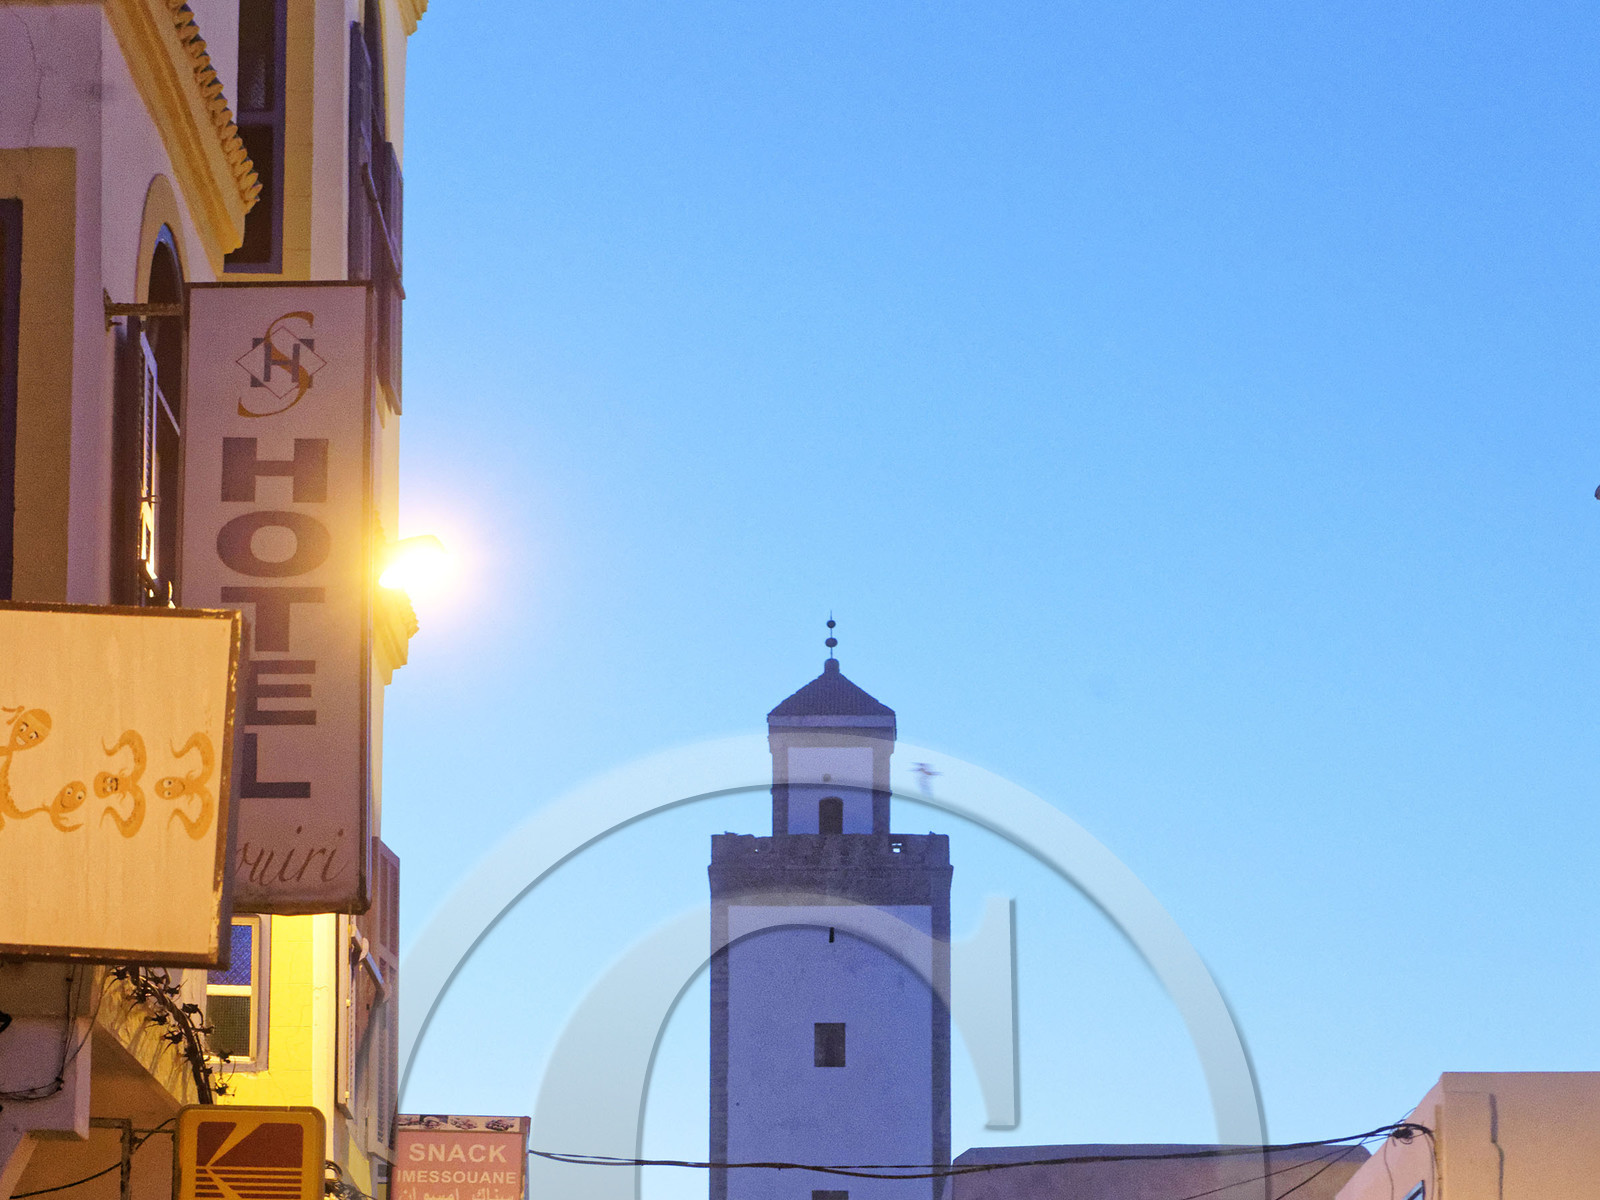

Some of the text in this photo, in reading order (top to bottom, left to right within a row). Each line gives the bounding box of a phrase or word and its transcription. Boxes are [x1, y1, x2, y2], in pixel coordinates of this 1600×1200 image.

[216, 437, 332, 799] HOTEL
[408, 1143, 507, 1163] SNACK
[397, 1169, 517, 1184] IMESSOUANE
